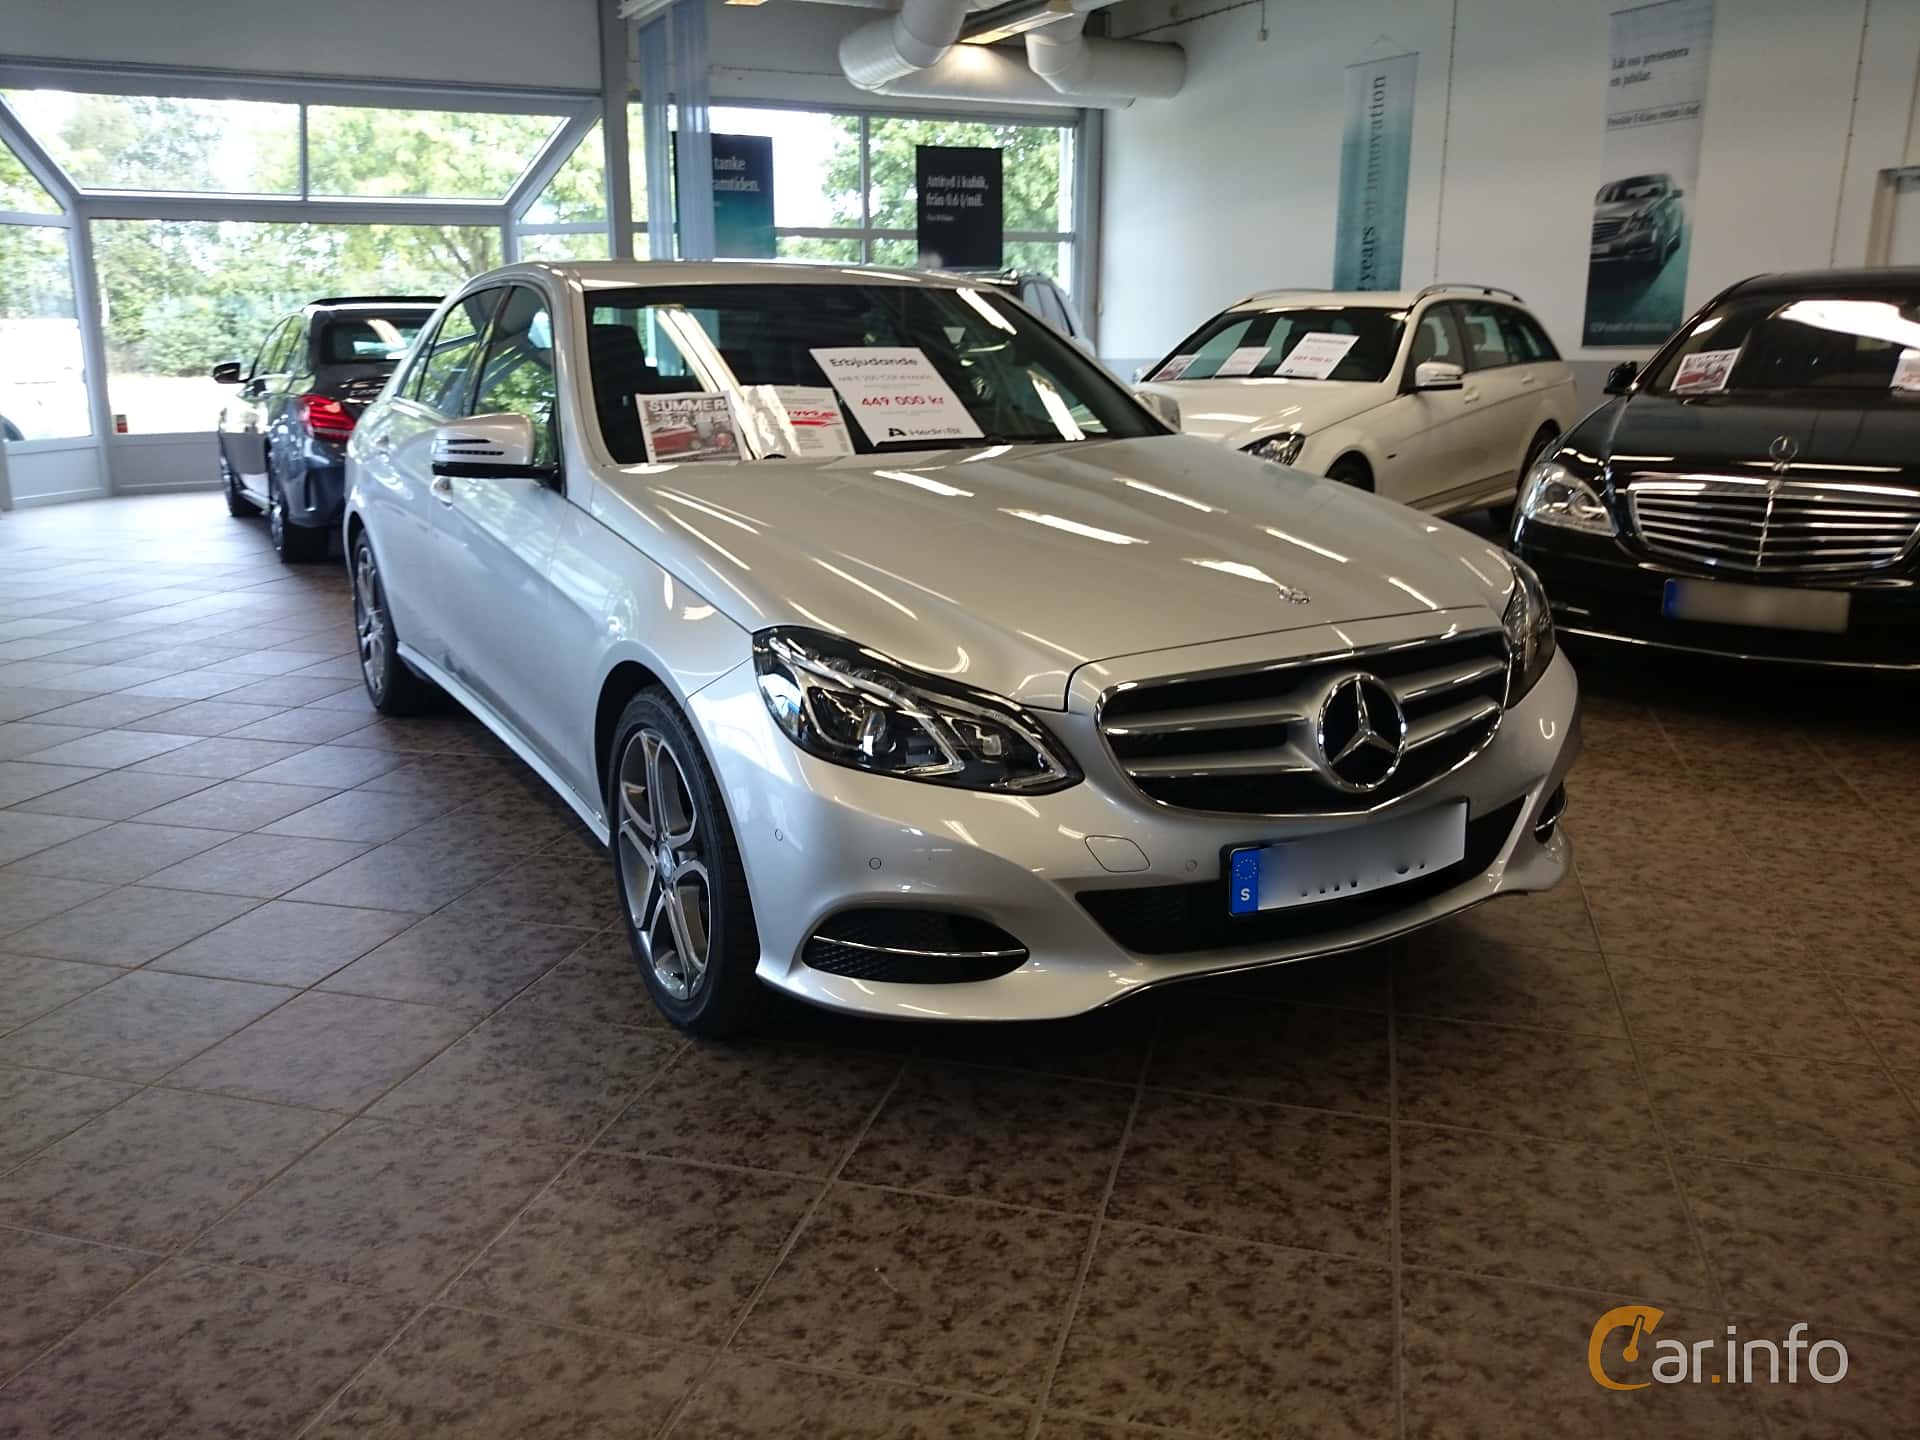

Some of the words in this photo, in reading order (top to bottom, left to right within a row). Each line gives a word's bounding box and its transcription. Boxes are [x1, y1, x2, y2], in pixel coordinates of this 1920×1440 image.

[1358, 225, 1377, 284] years
[829, 356, 919, 369] Erbjudande
[861, 396, 889, 407] 449
[895, 395, 926, 406] 000
[1240, 888, 1251, 902] S
